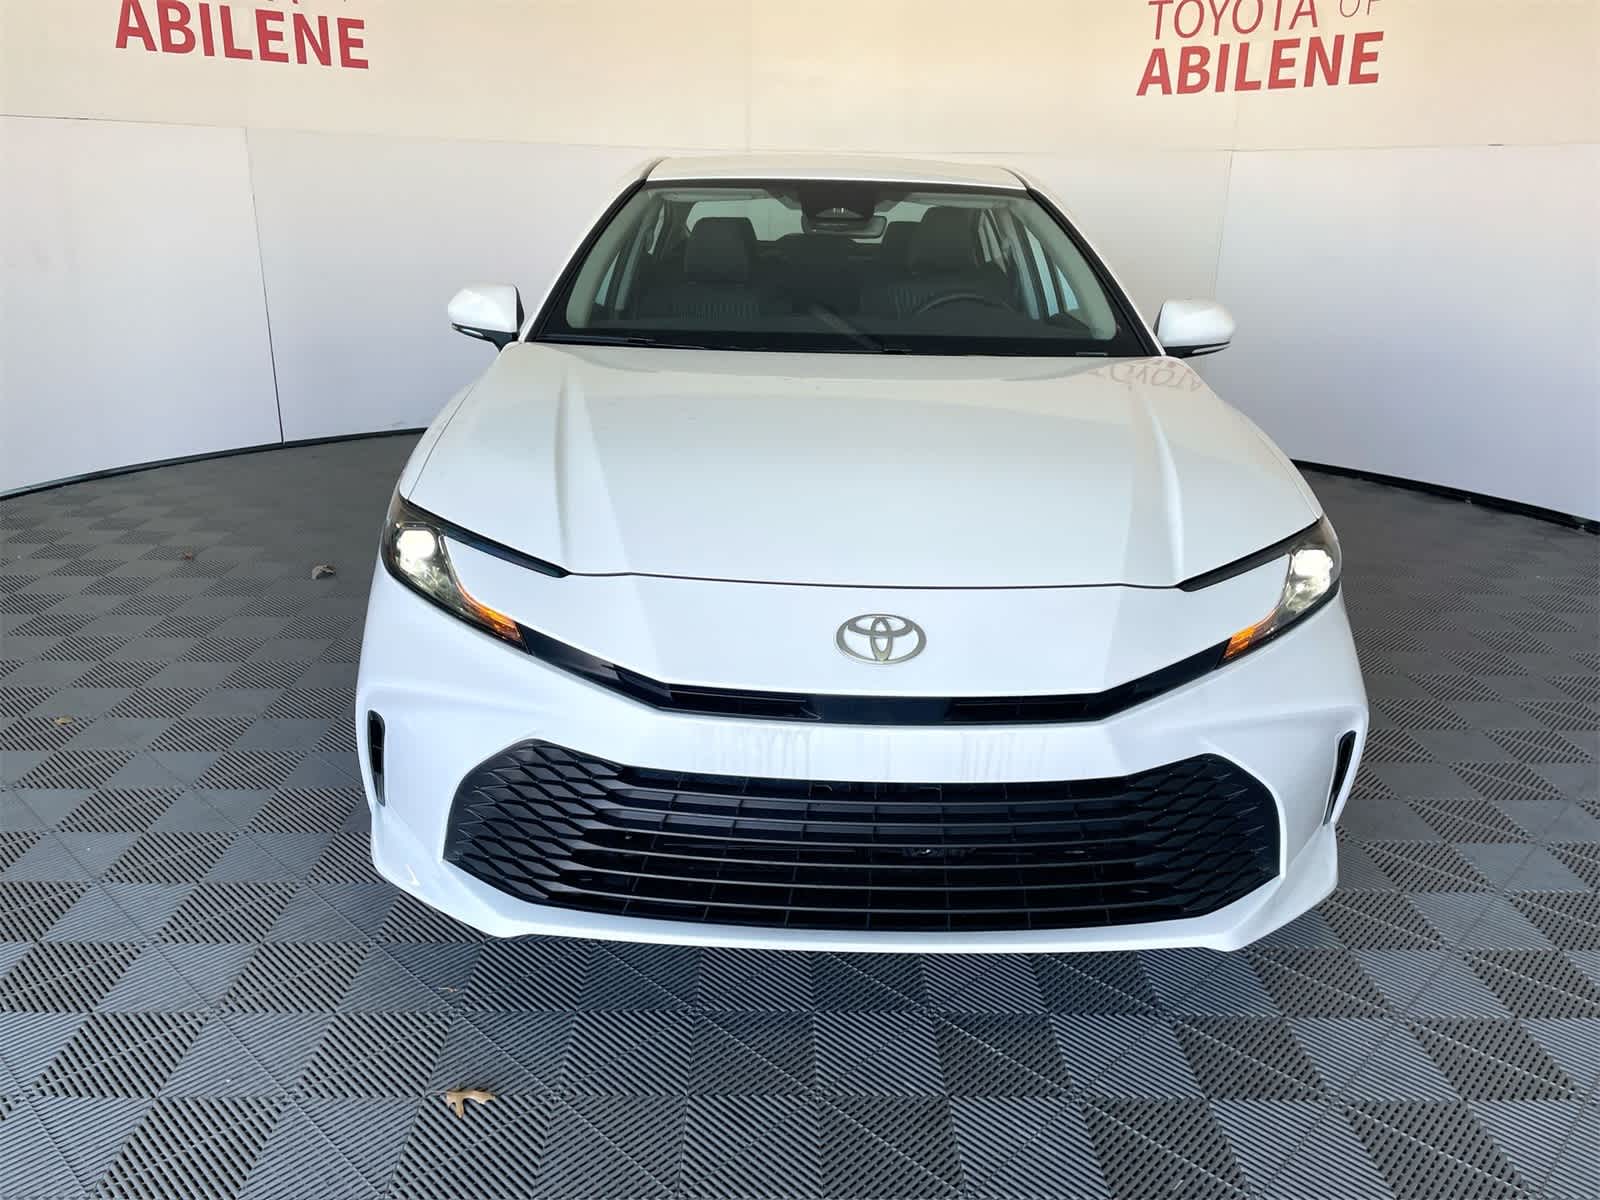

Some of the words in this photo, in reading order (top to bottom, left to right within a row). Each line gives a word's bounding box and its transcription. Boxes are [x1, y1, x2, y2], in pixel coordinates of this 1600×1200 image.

[115, 0, 369, 69] ABILENE
[1148, 0, 1318, 40] TOYOTA
[1136, 31, 1384, 96] ABILENE
